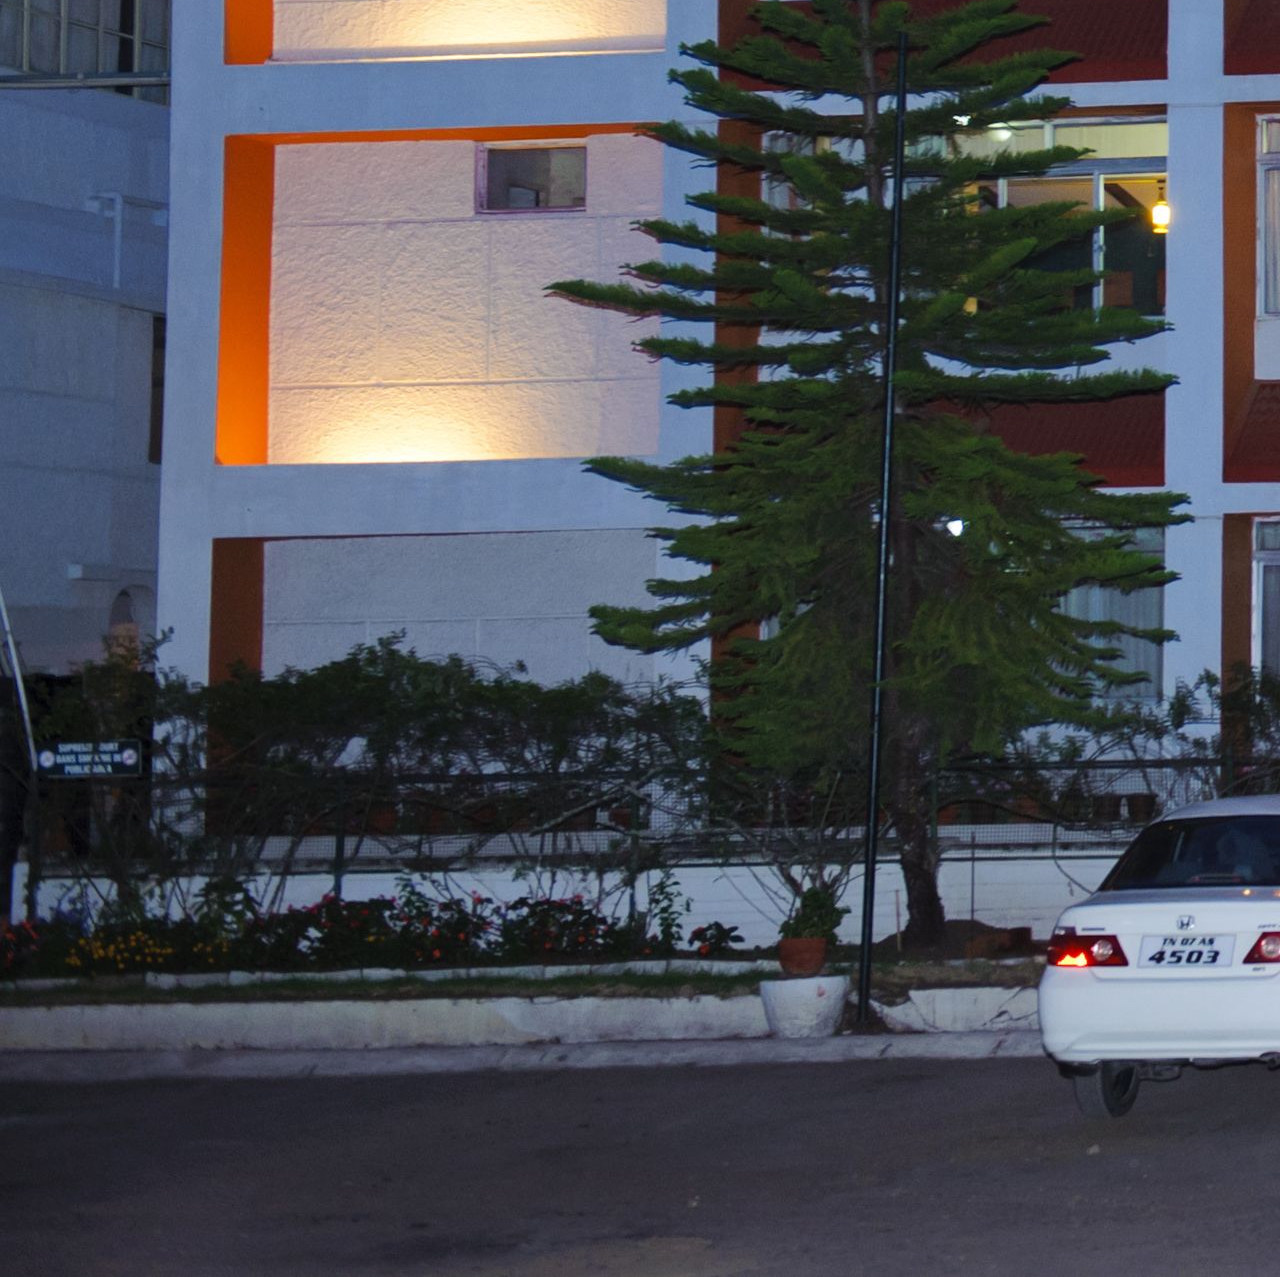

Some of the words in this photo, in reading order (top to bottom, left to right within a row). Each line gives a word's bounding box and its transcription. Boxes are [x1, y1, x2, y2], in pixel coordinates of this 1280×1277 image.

[1162, 937, 1177, 946] TN
[1180, 937, 1197, 946] 07
[1148, 950, 1220, 964] 4503
